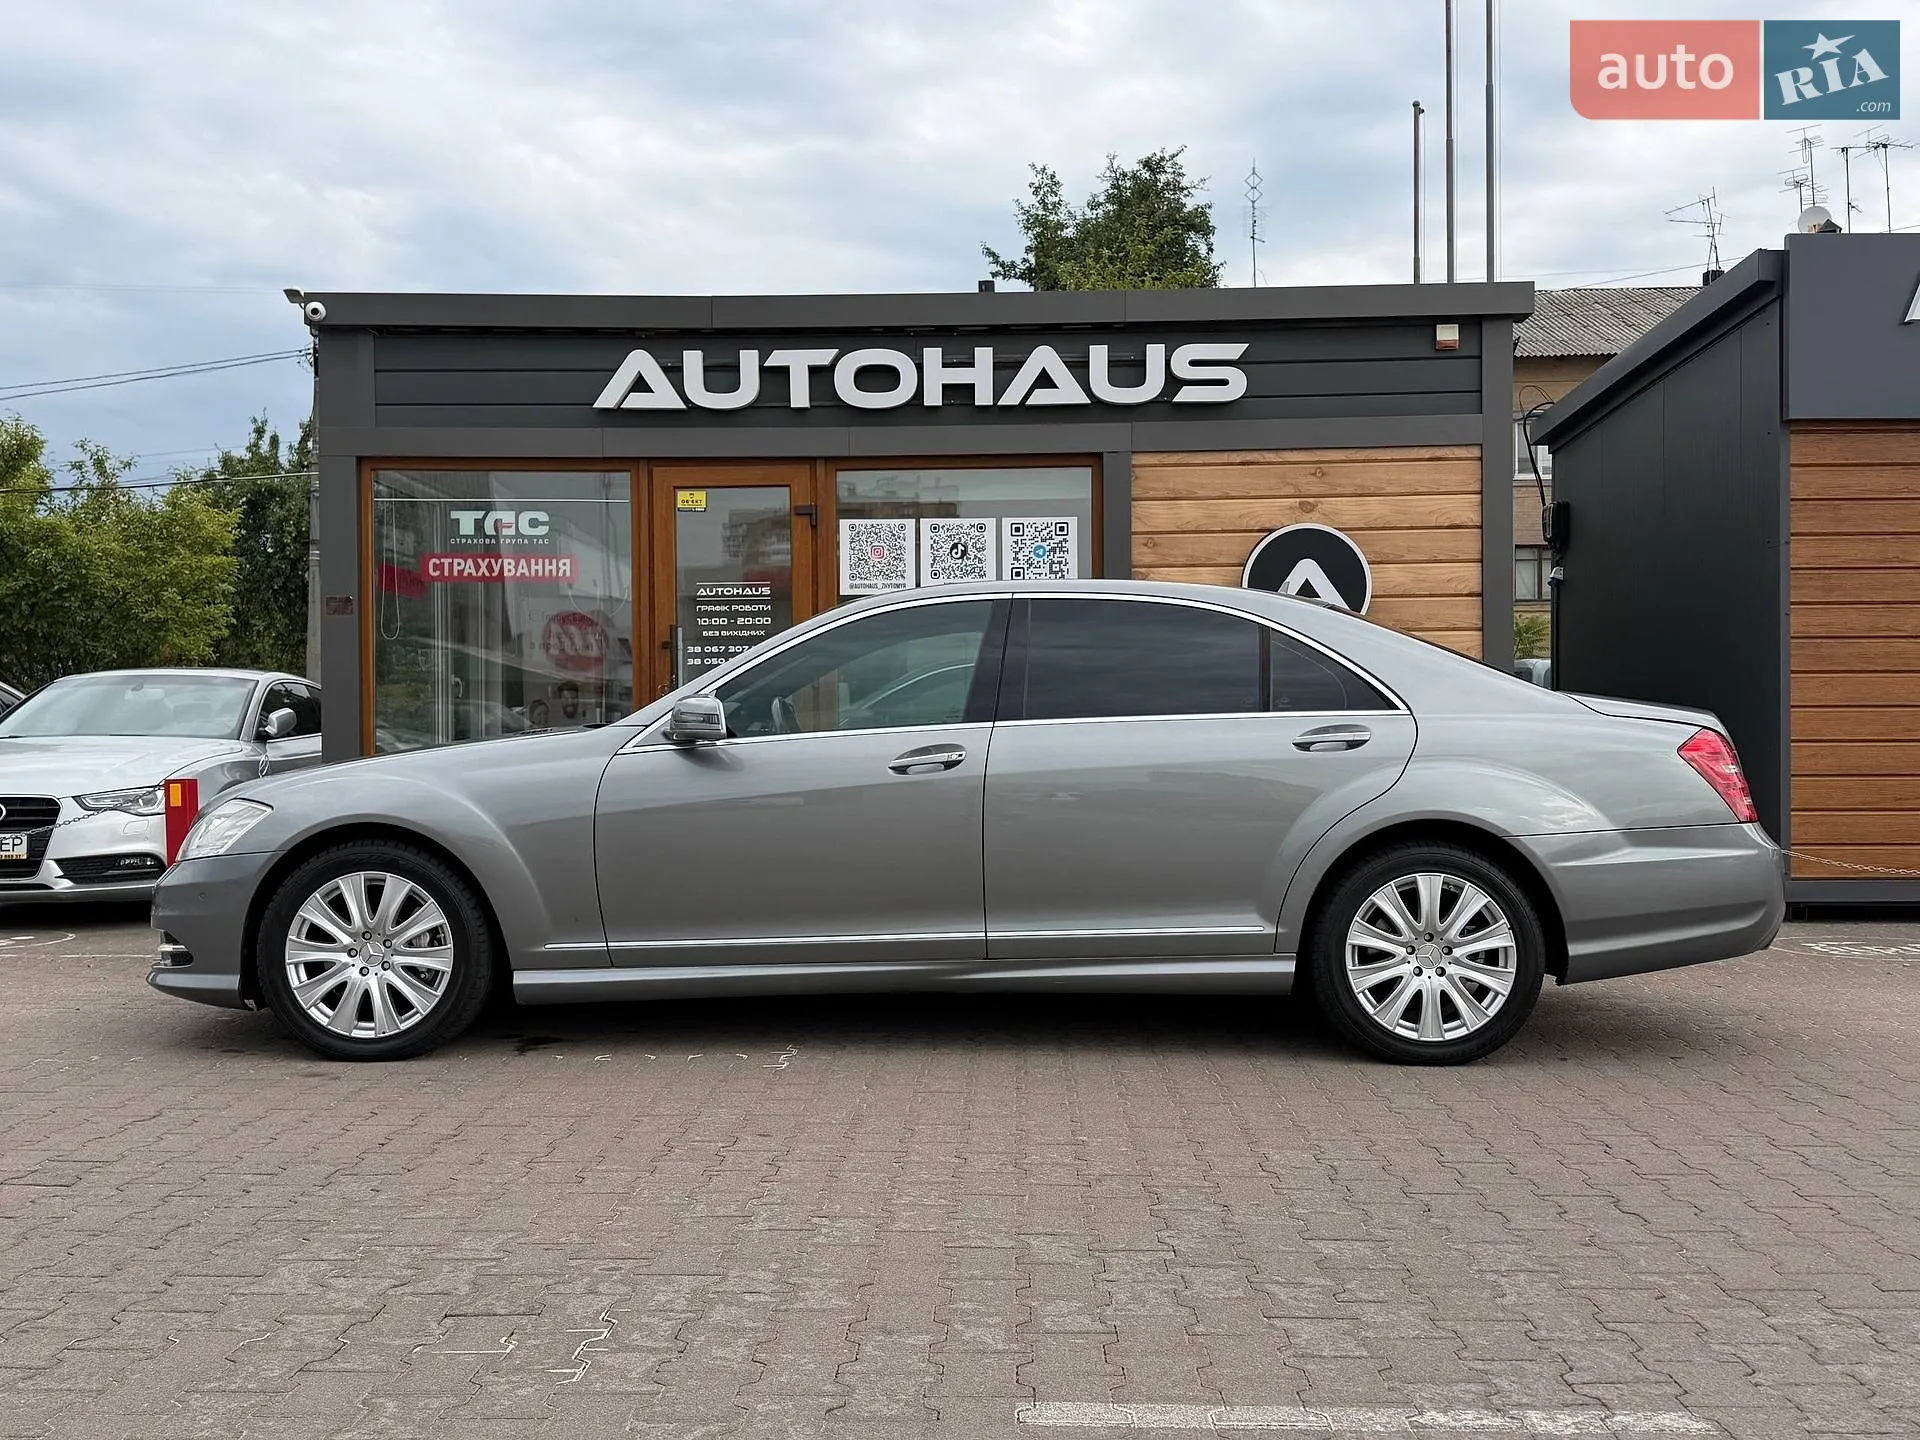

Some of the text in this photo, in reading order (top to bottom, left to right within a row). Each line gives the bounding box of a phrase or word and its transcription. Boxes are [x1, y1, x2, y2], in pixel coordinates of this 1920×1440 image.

[593, 342, 1250, 411] AUTOHAUS
[428, 558, 571, 577] СТРАХУВАННЯ
[696, 587, 771, 596] AUTOHAUS
[737, 617, 771, 625] 20:00
